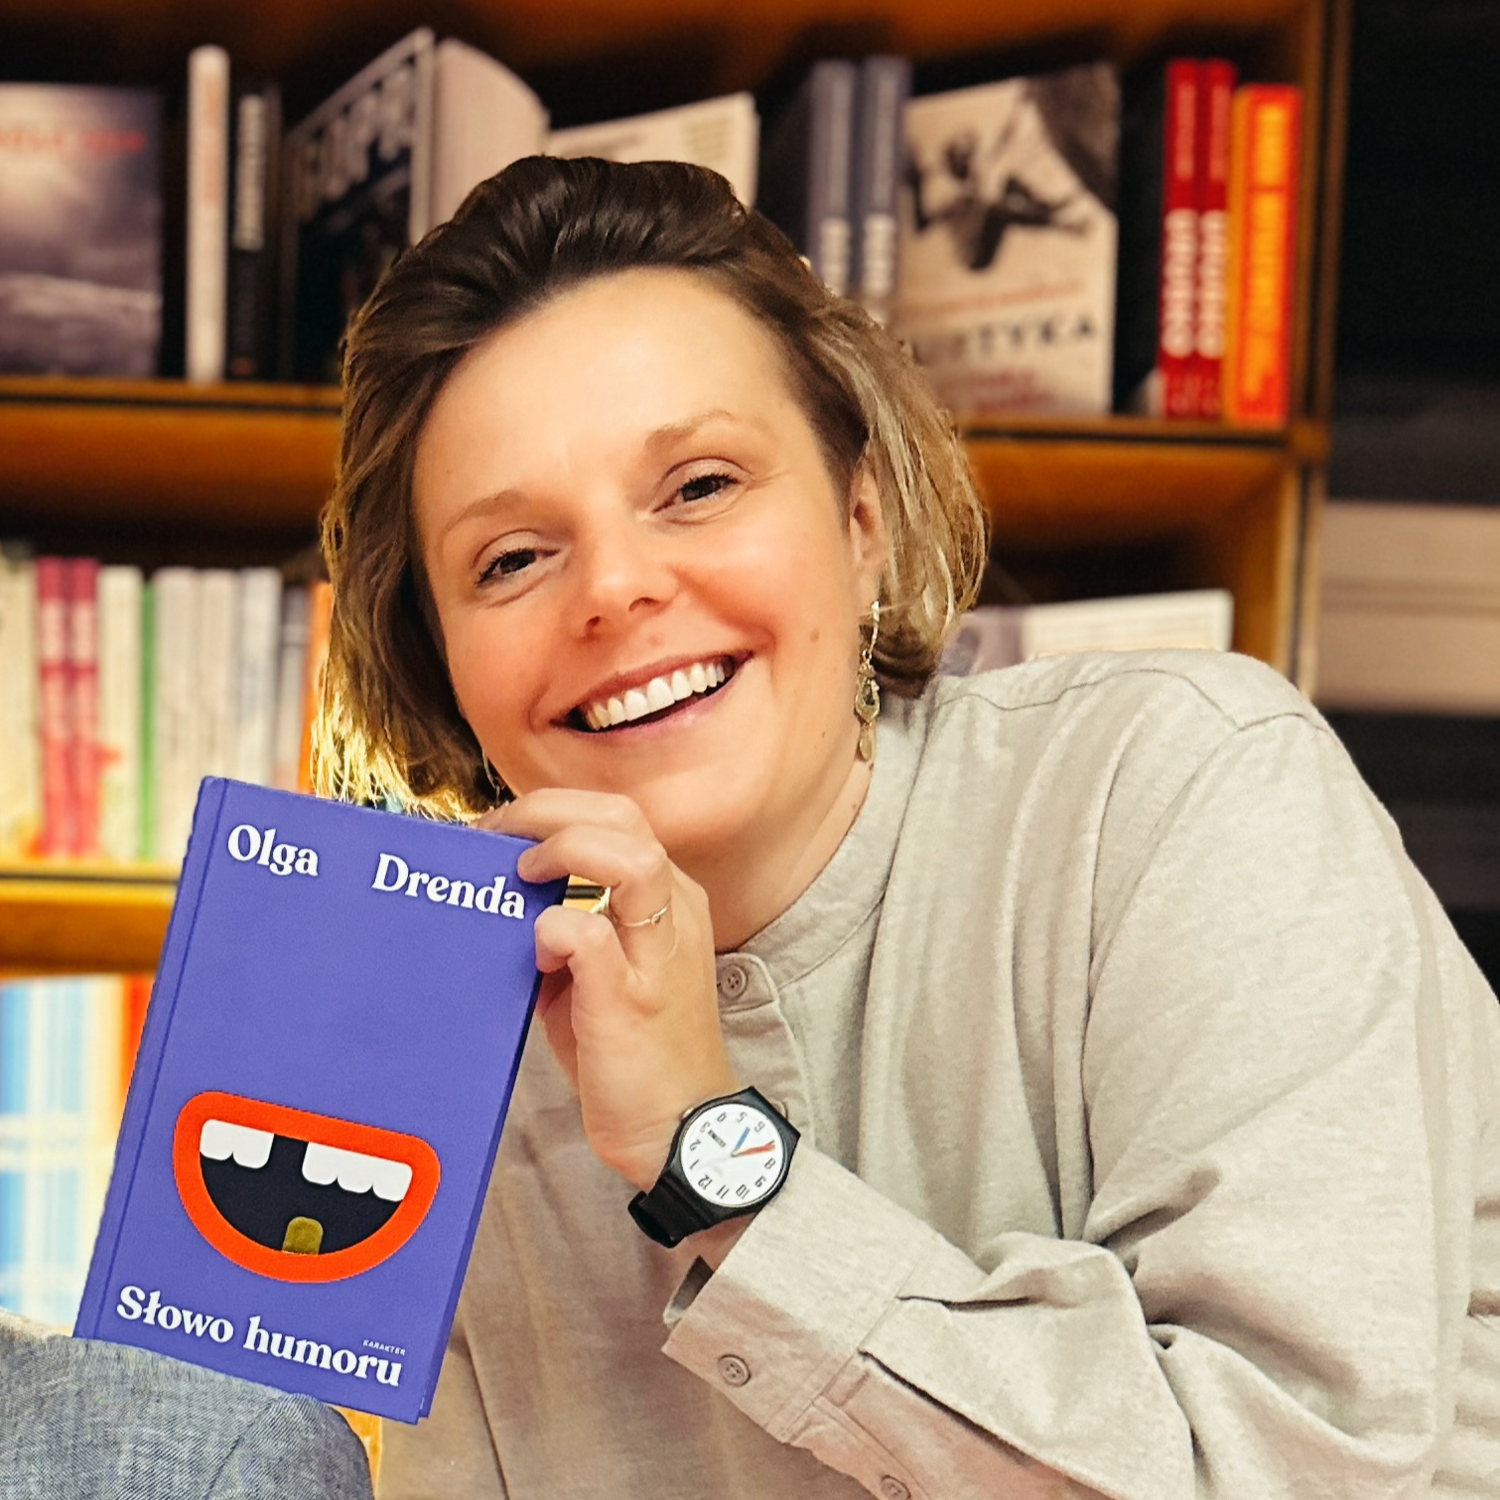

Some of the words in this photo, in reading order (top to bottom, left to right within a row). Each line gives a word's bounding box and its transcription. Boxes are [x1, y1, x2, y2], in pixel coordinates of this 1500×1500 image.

[227, 824, 318, 877] Olga
[371, 852, 525, 919] Drenda
[116, 1285, 235, 1343] Słowo
[242, 1315, 403, 1388] humoru
[361, 1338, 407, 1357] KARAKTER
